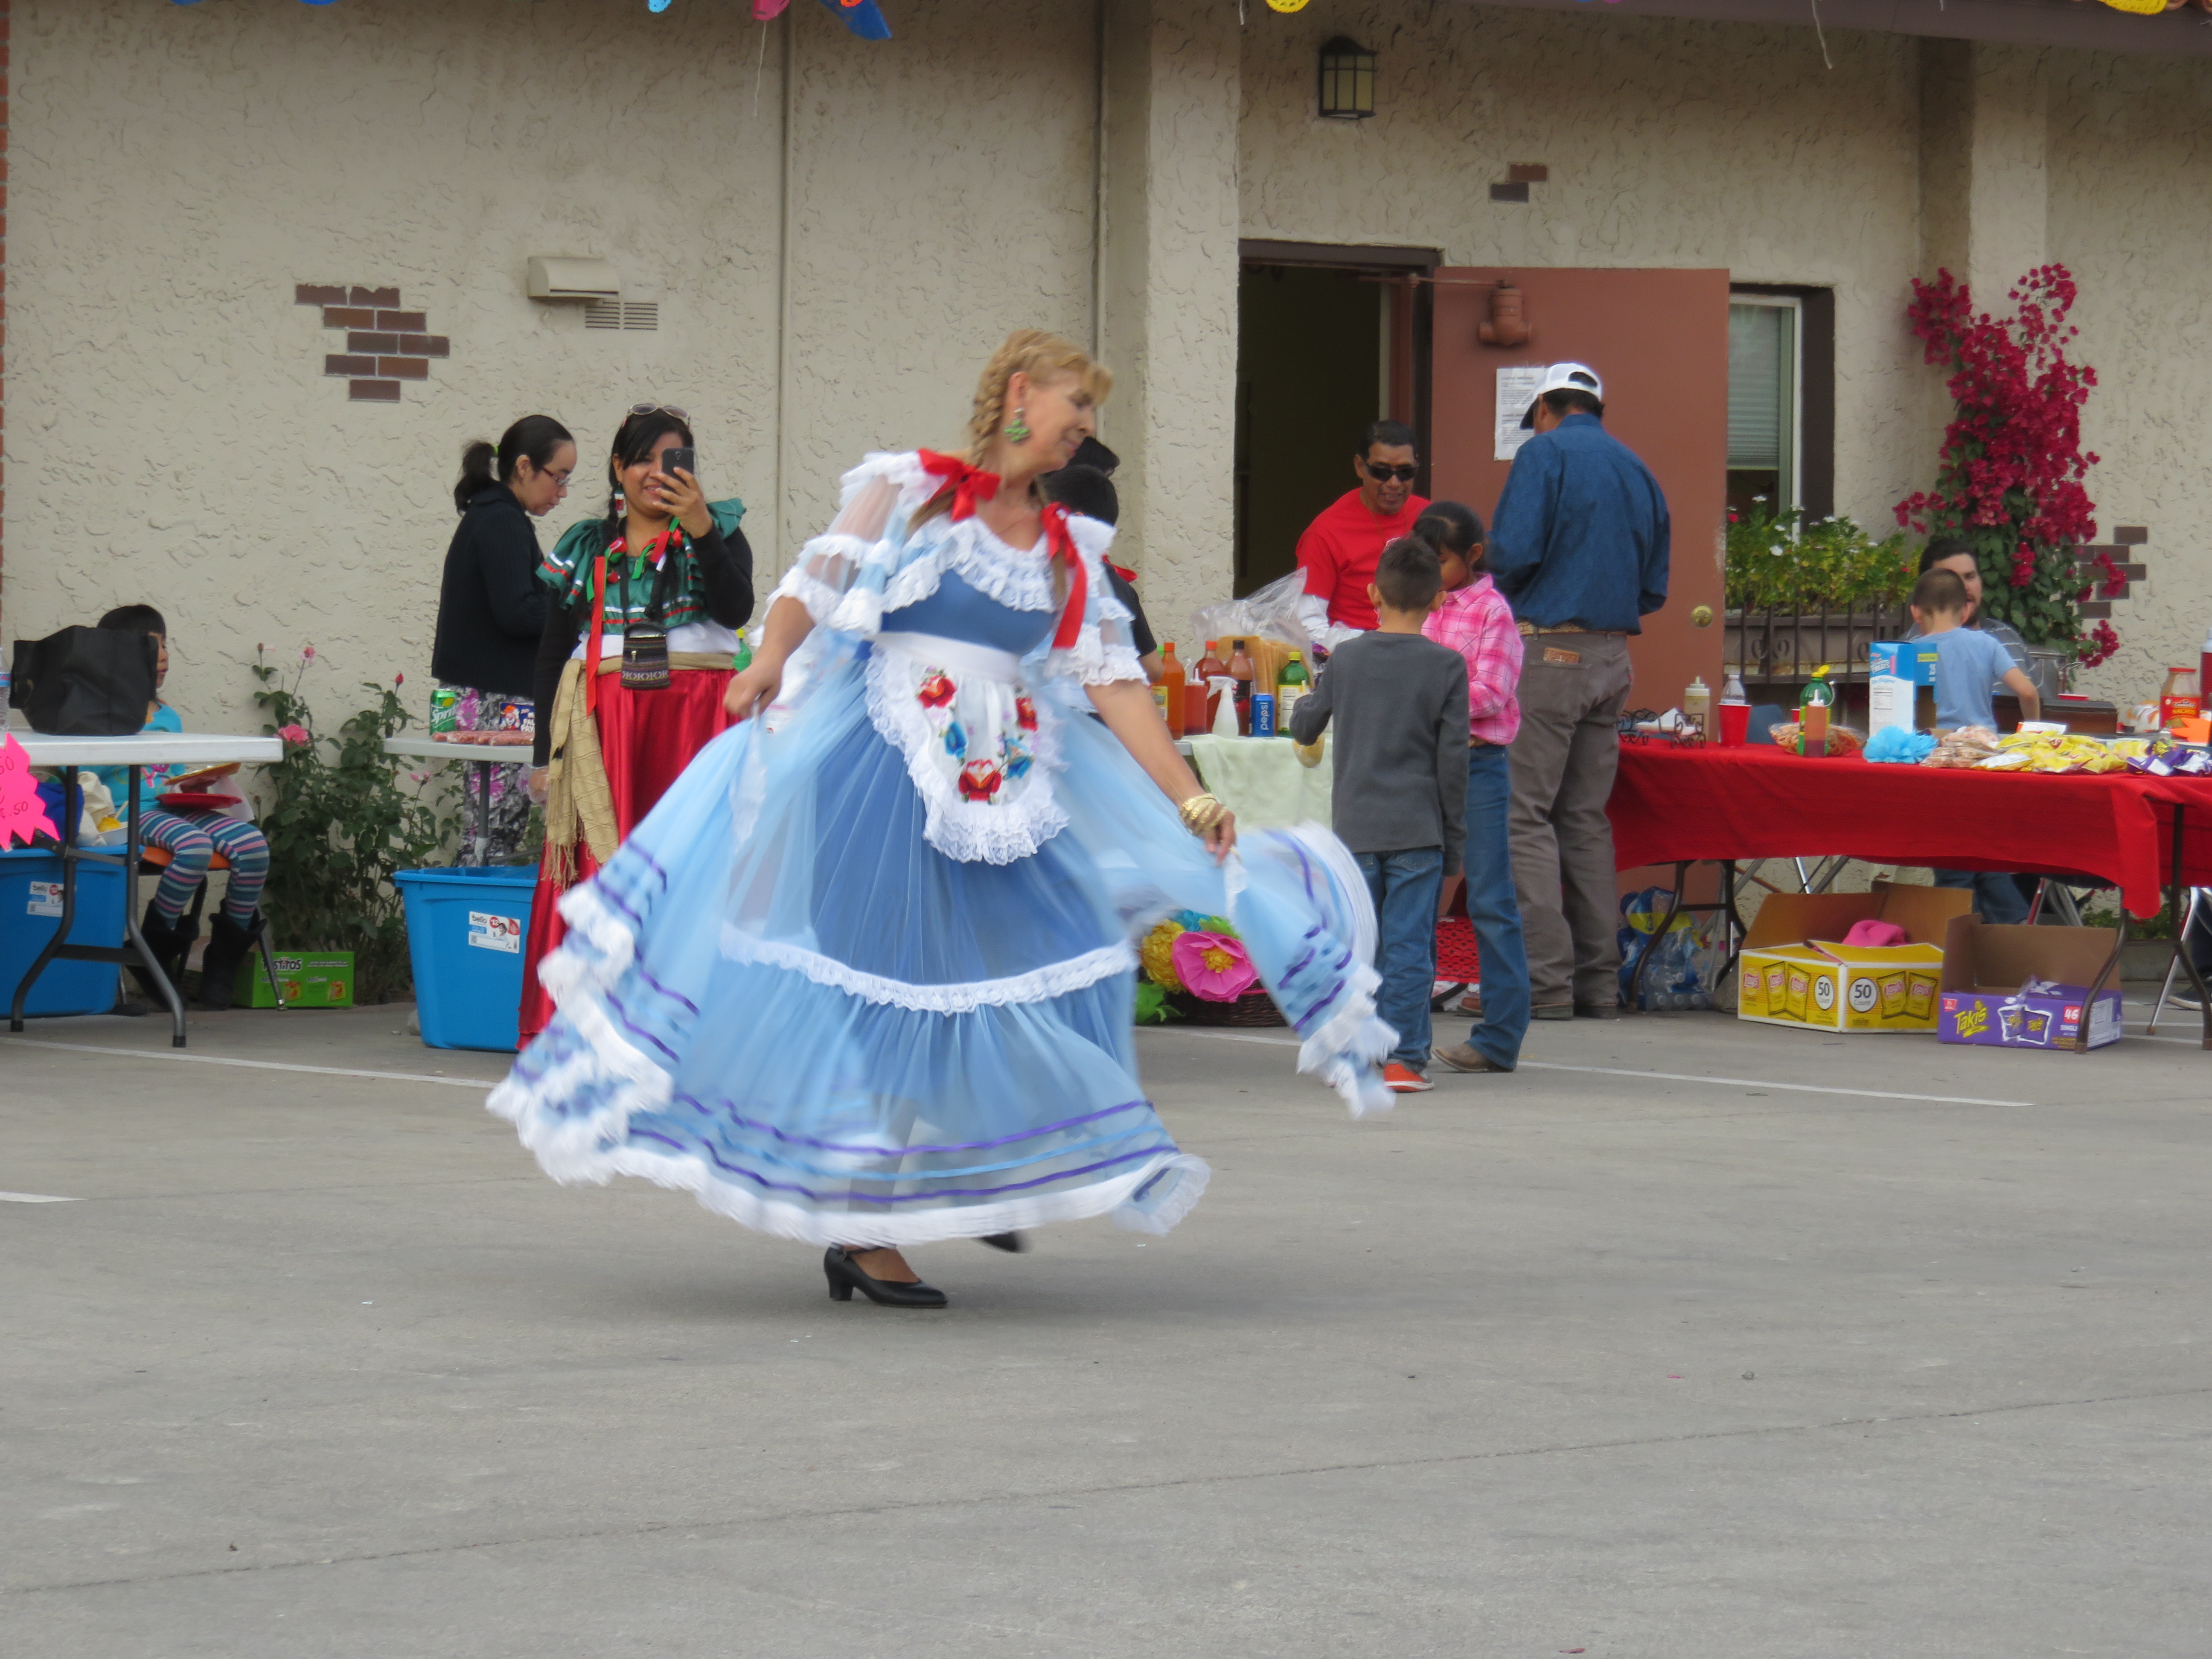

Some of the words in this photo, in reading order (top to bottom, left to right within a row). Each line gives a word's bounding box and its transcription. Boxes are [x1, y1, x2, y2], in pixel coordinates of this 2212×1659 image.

[431, 704, 456, 725] Sprit
[1260, 702, 1270, 731] pepsi
[1818, 982, 1830, 996] 50
[1854, 984, 1872, 998] 50
[1954, 1001, 1988, 1034] Takis
[2064, 1008, 2079, 1020] 46
